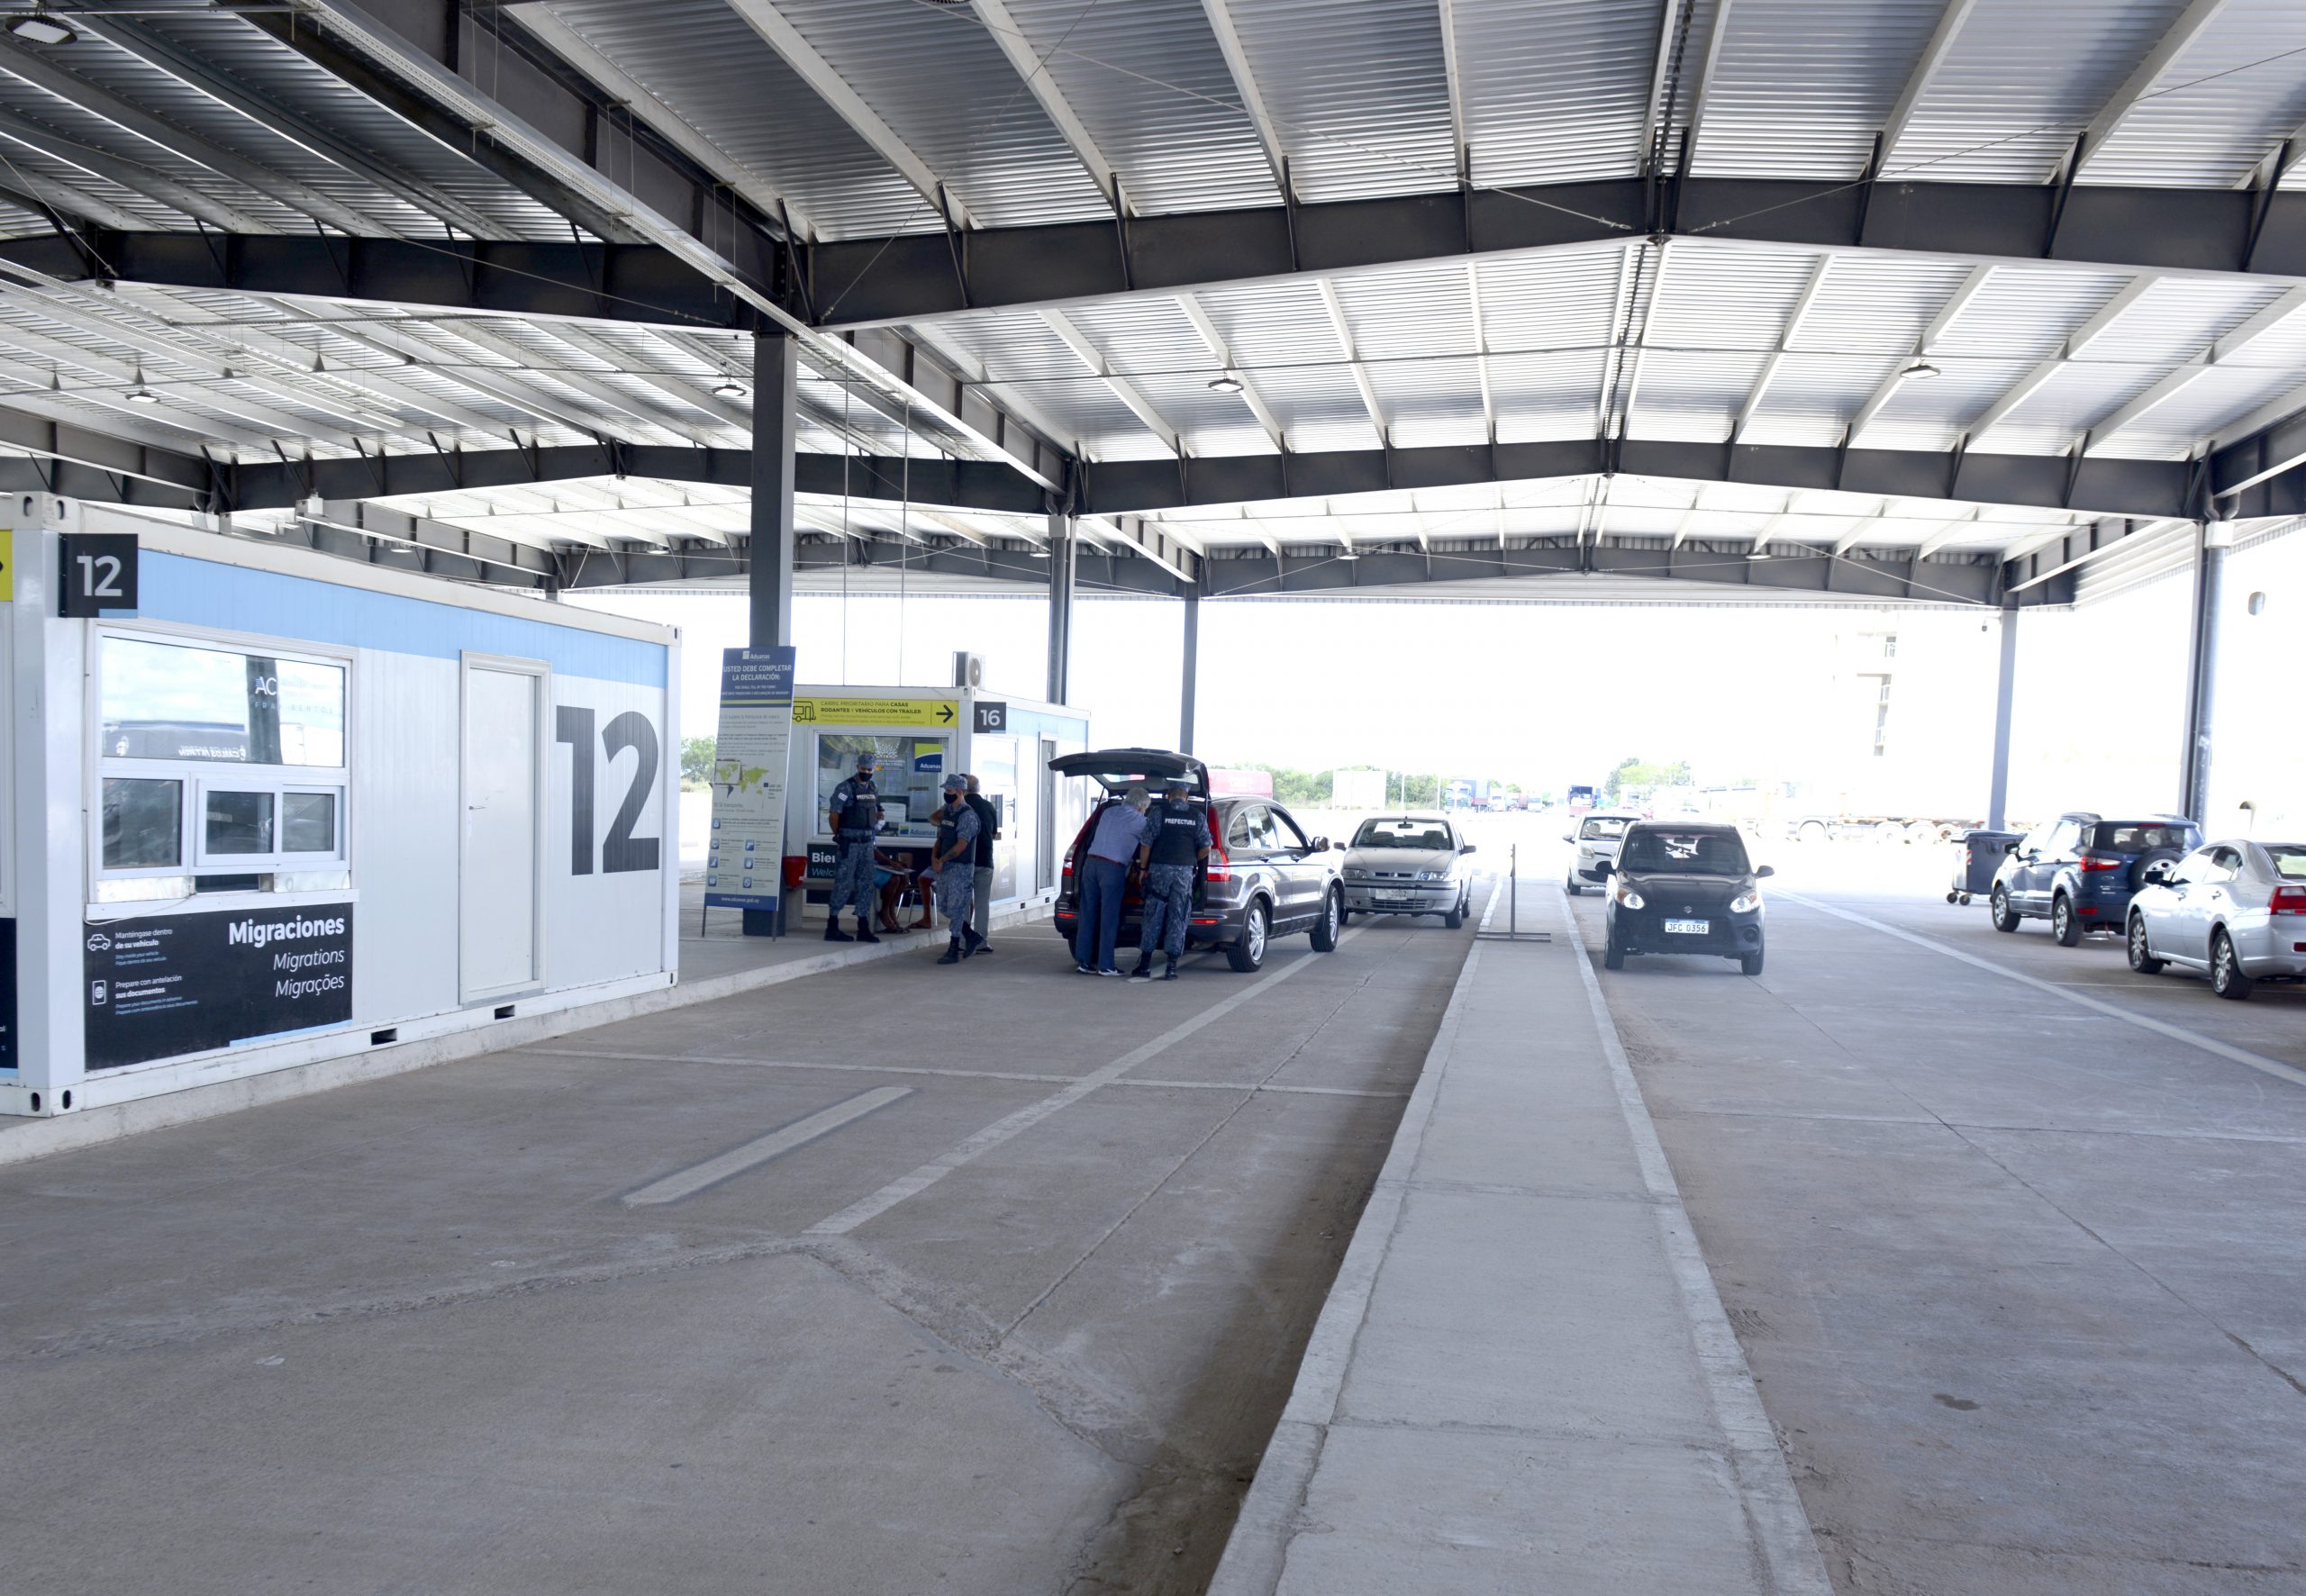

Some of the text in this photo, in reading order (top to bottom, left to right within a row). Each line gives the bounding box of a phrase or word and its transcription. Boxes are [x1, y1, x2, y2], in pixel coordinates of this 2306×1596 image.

[77, 555, 123, 596] 12
[758, 664, 792, 672] COMPLETAR
[980, 709, 1001, 726] 16
[556, 704, 659, 876] 12
[1165, 818, 1196, 826] PREFECTURA
[228, 914, 345, 948] Migraciones
[1667, 923, 1706, 933] JFC 0356
[273, 948, 345, 973] Migrations
[115, 980, 140, 989] Prepare
[127, 987, 166, 997] documentos
[275, 974, 345, 999] Migrações
